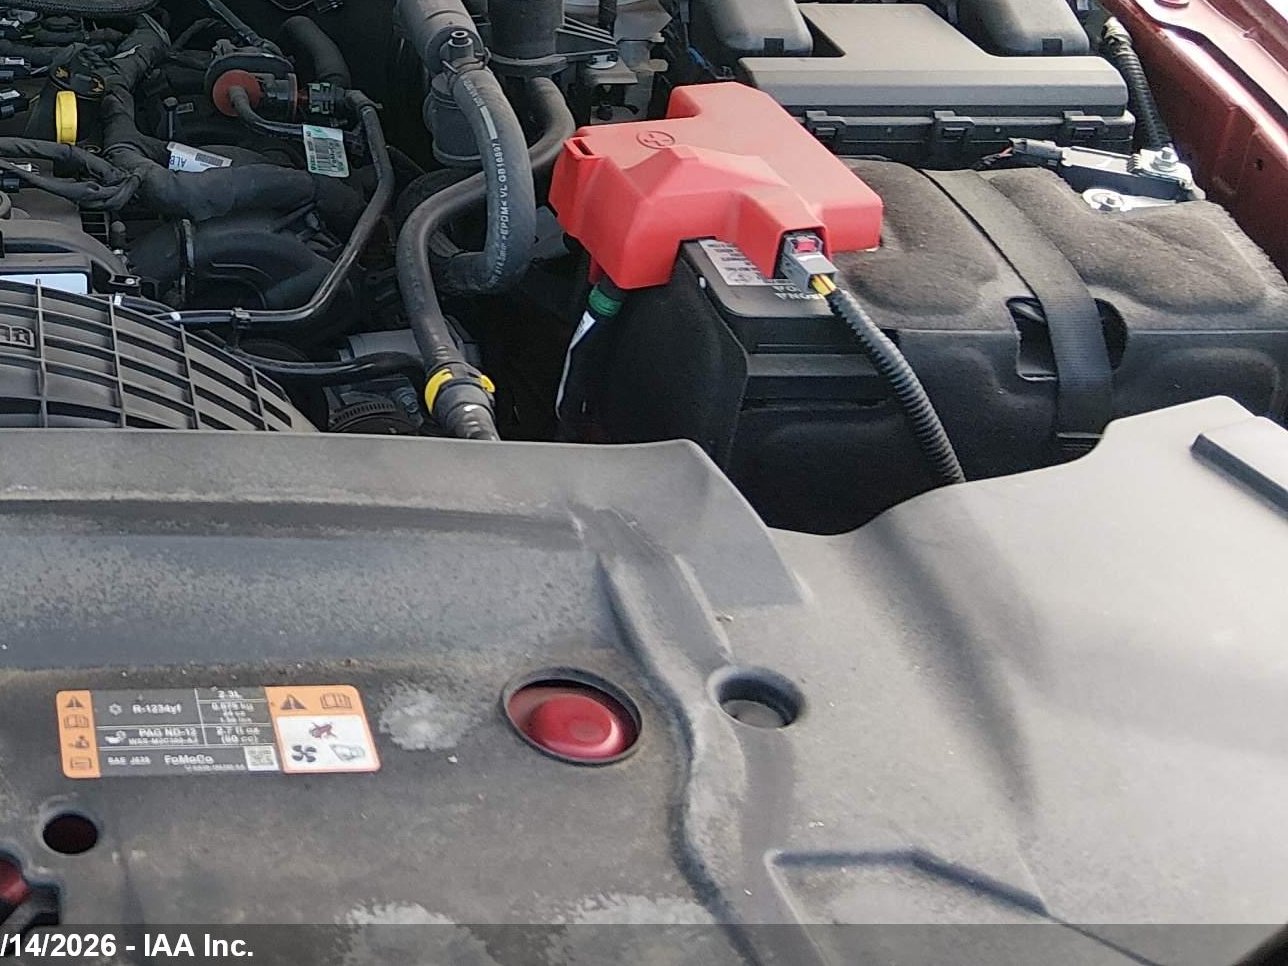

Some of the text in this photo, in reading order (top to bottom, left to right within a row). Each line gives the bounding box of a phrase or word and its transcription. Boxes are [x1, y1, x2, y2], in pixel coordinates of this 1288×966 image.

[217, 690, 242, 699] 2.3L
[132, 703, 182, 714] R-1234yf
[138, 726, 197, 737] PAG ND-12
[164, 754, 214, 766] FoMoCo
